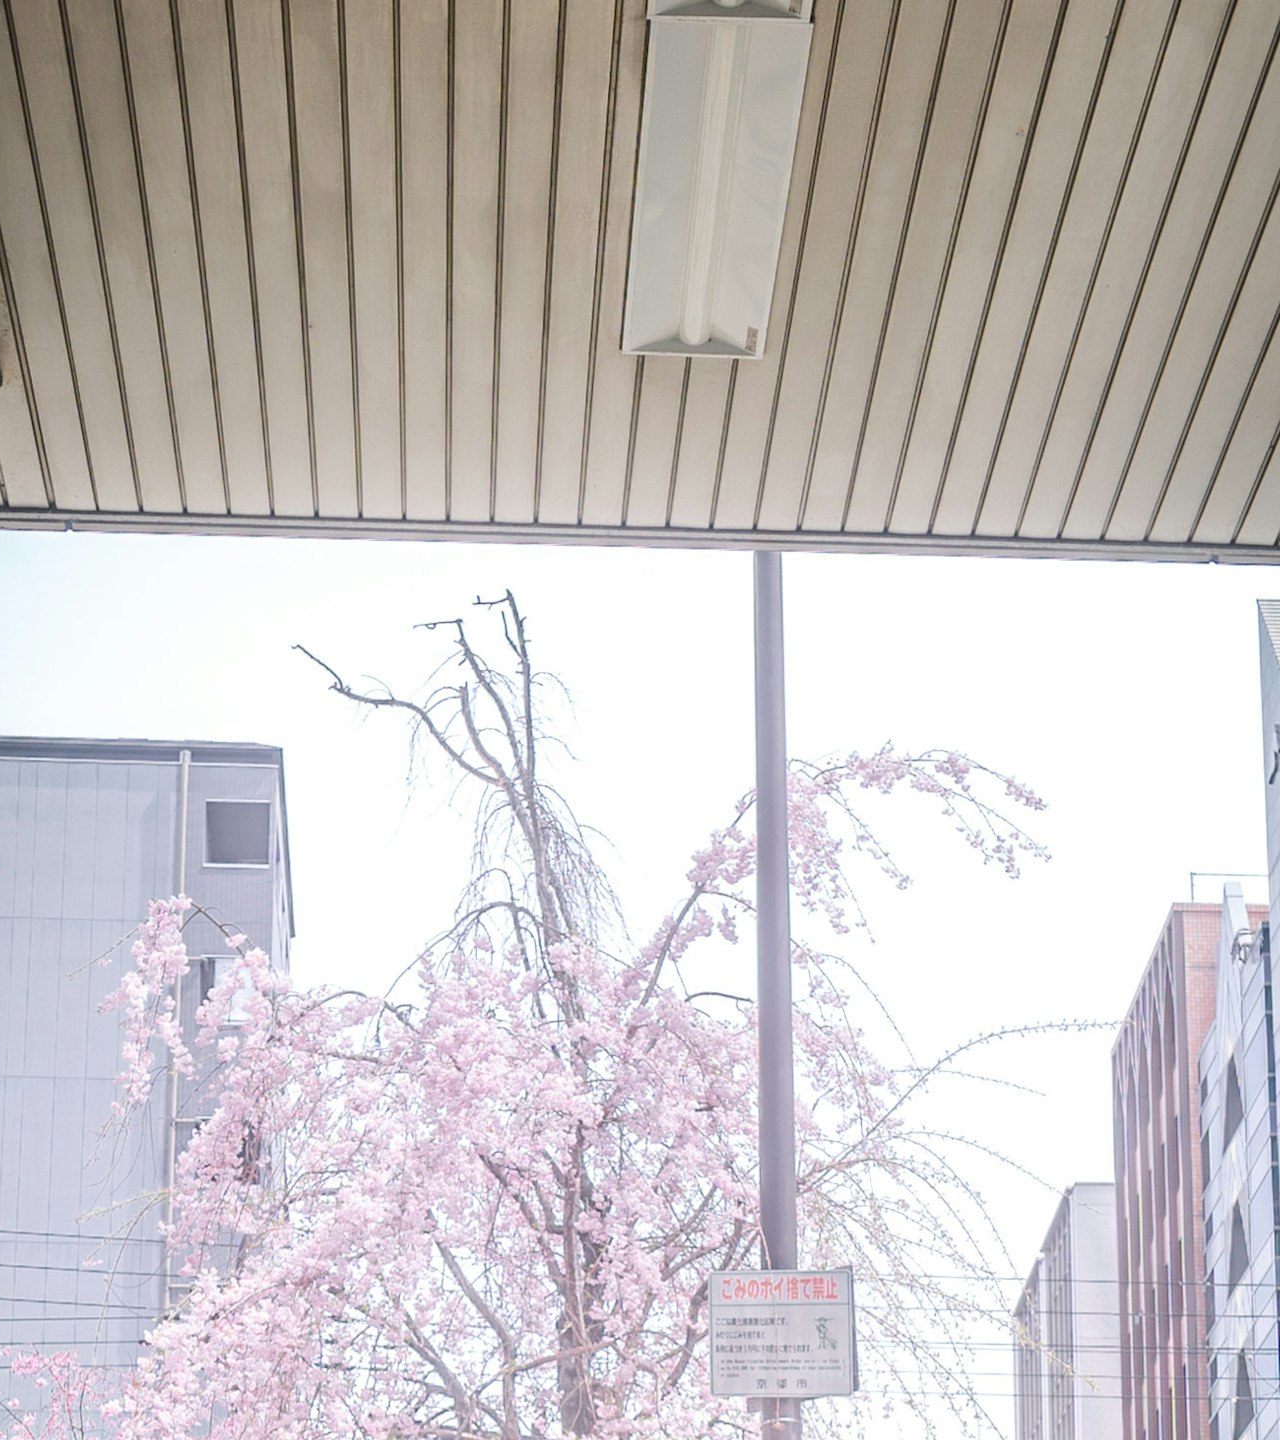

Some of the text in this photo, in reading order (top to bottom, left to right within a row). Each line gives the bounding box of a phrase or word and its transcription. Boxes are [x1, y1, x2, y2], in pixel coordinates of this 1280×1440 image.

[722, 1276, 839, 1300] ごみのポイ捨て禁止
